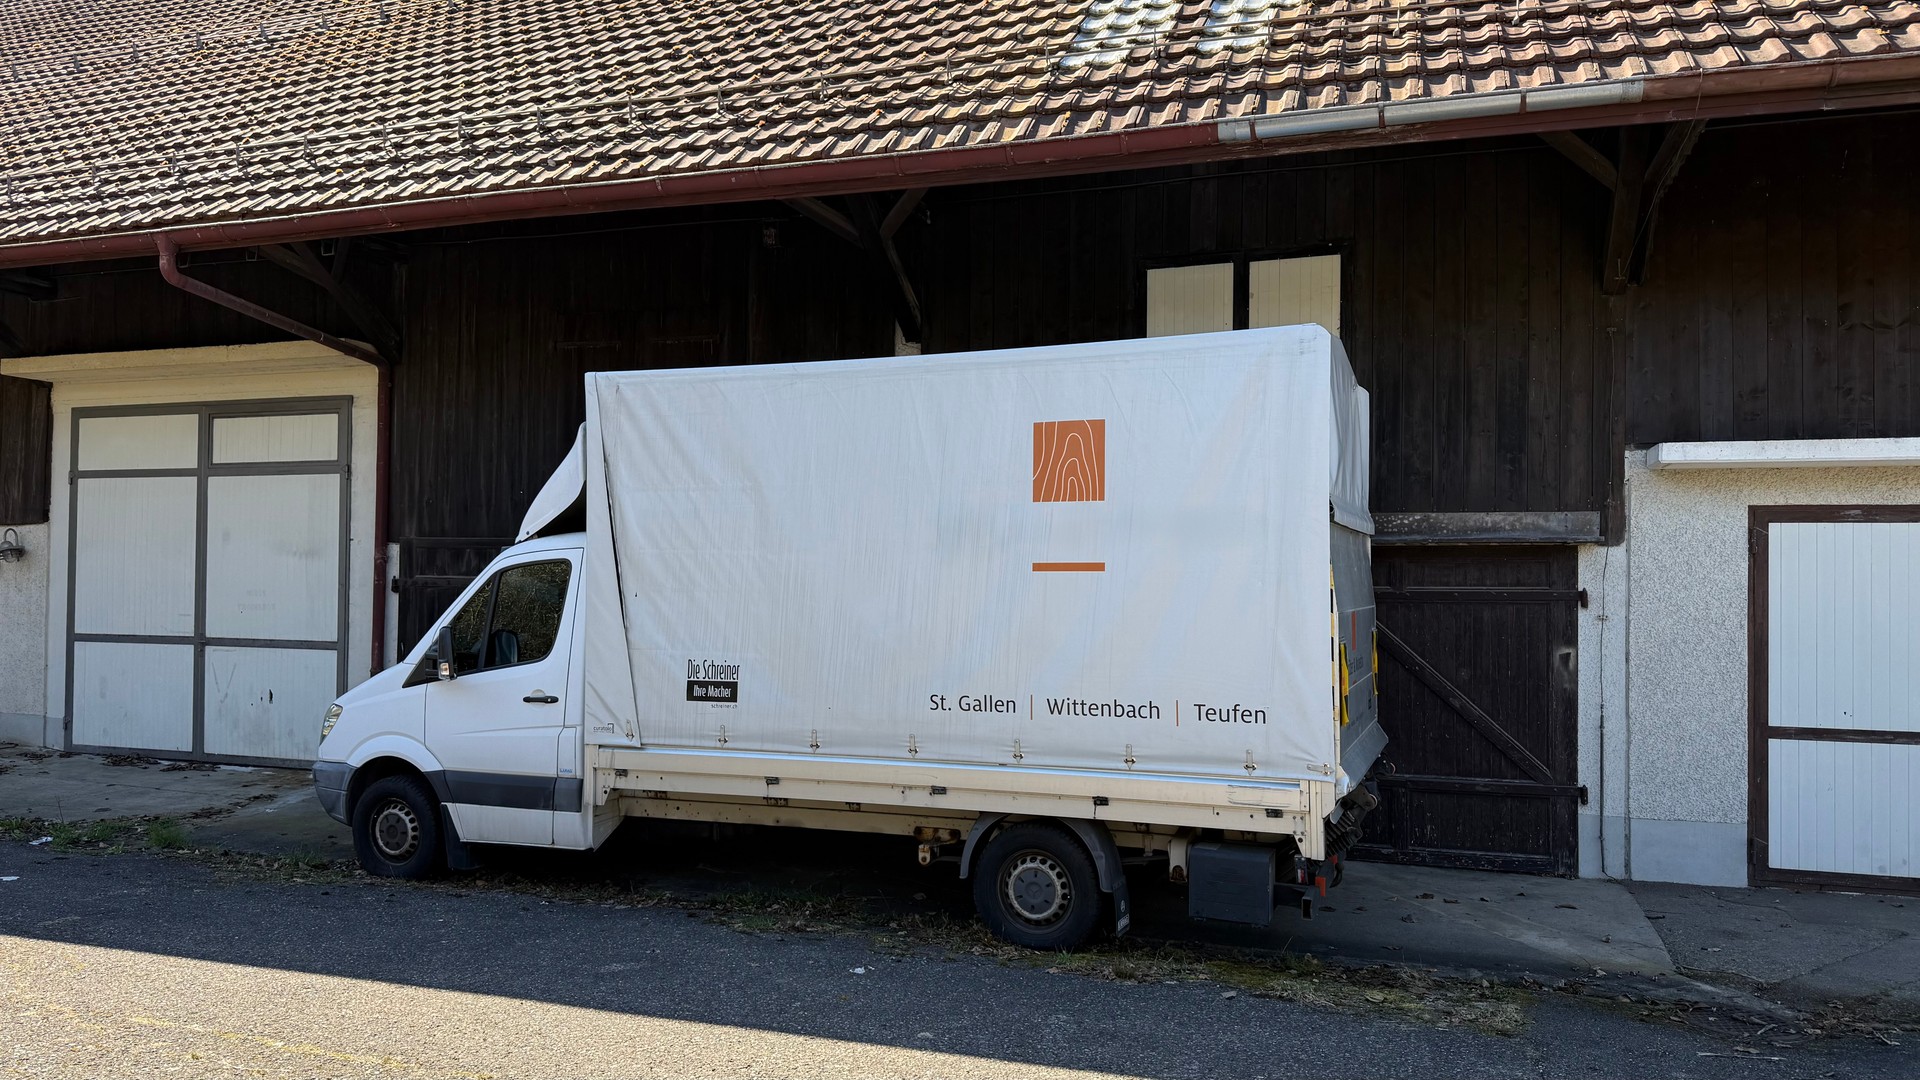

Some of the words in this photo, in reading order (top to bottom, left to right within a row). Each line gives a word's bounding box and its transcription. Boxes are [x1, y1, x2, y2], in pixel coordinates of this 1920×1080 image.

[687, 658, 700, 680] Die
[702, 659, 740, 681] Schreiner
[693, 684, 706, 697] Ihre
[707, 684, 732, 698] Macher
[929, 694, 952, 712] St.
[958, 694, 1016, 714] Gallen
[1046, 697, 1160, 720] Wittenbach
[1193, 703, 1267, 725] Teufen
